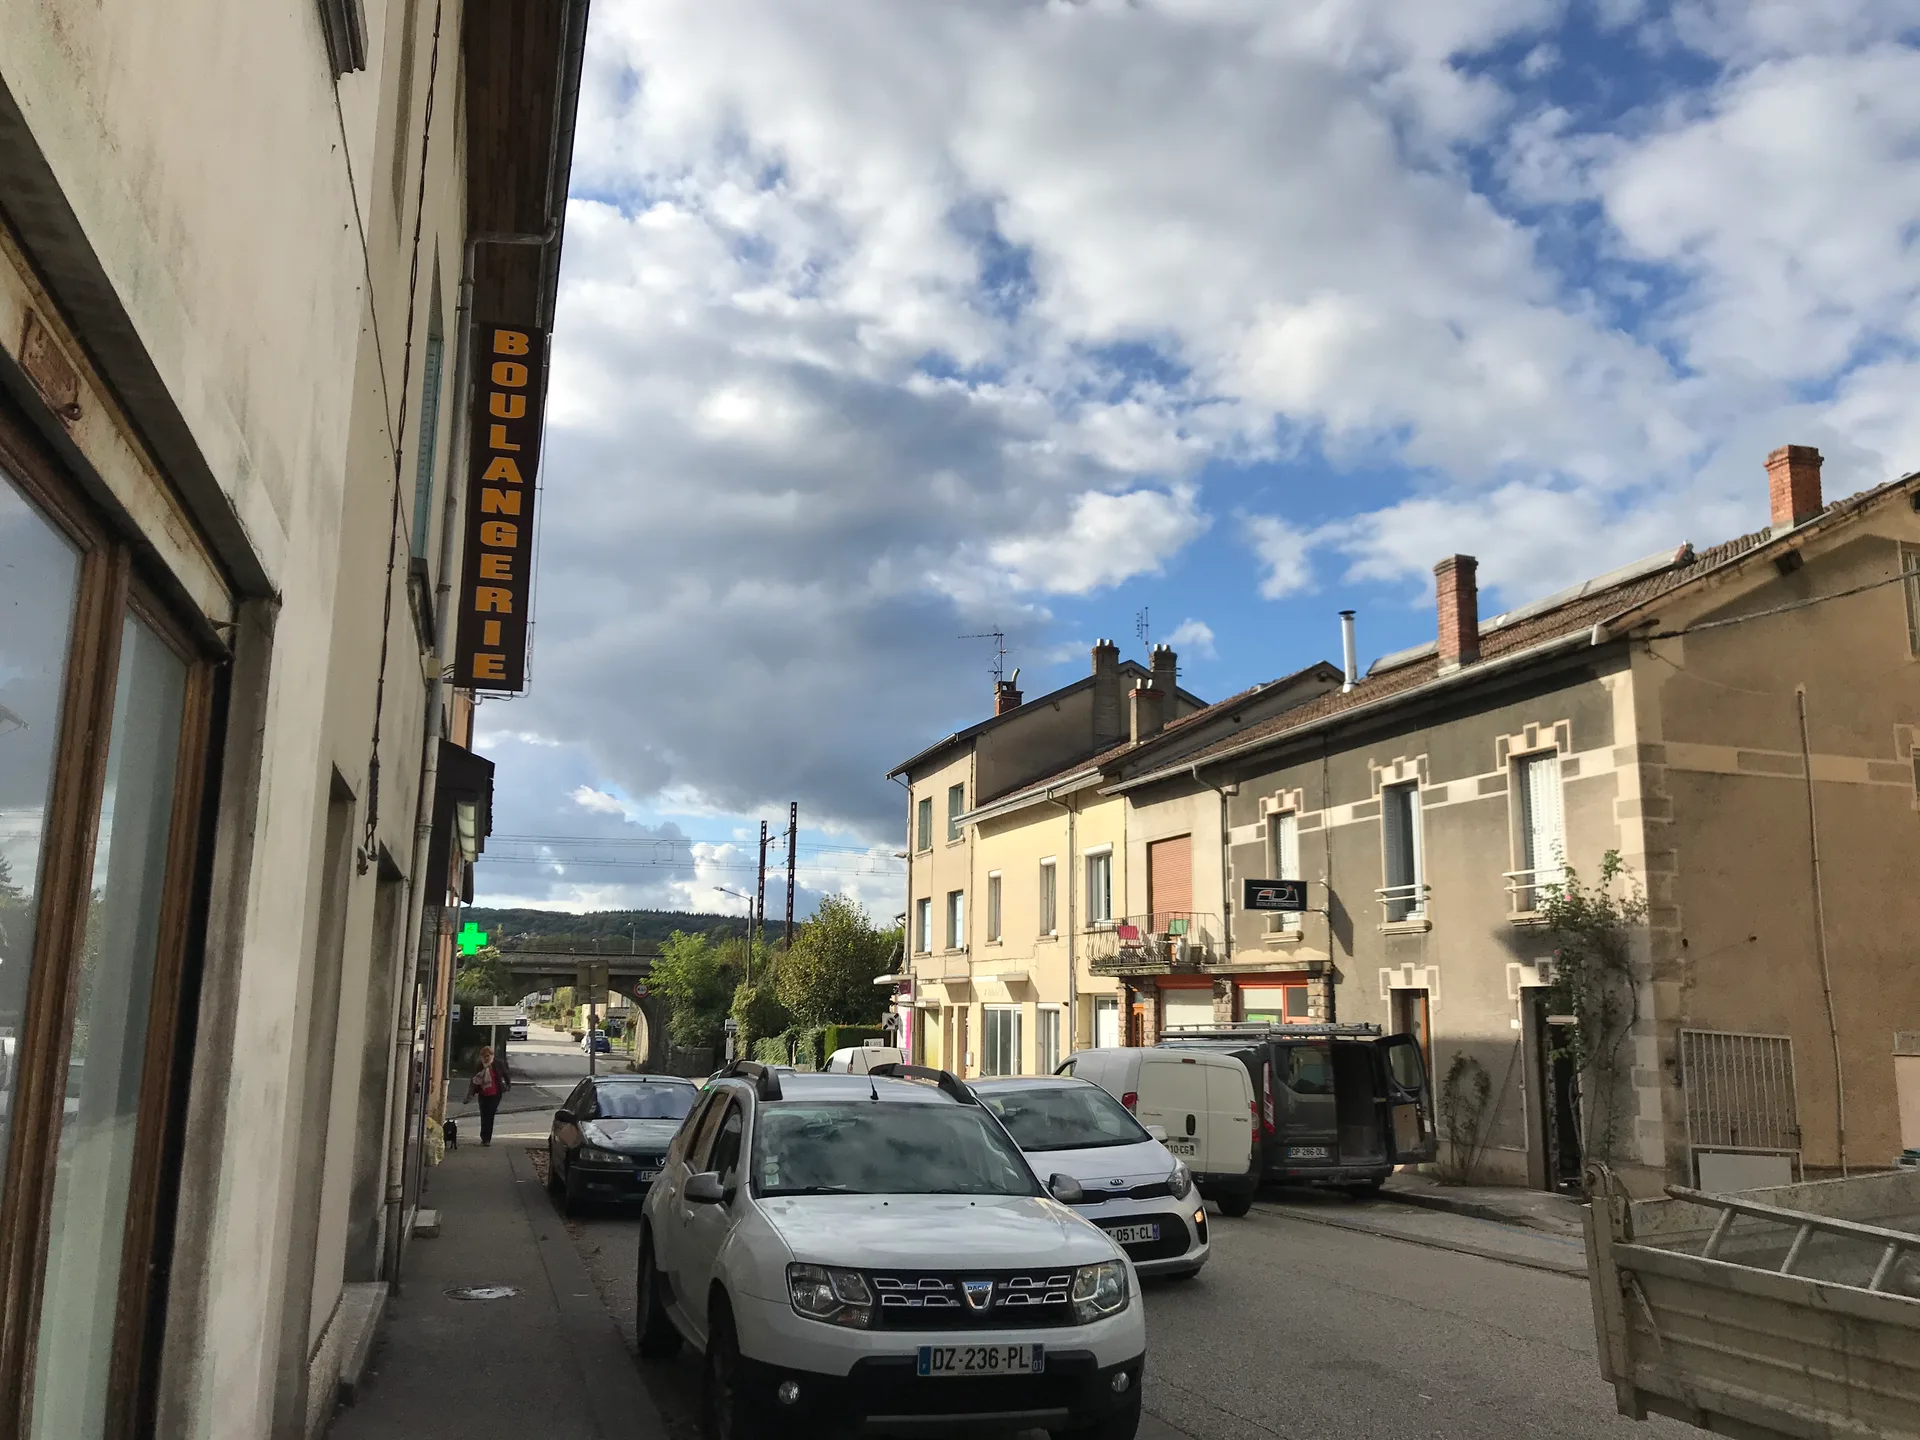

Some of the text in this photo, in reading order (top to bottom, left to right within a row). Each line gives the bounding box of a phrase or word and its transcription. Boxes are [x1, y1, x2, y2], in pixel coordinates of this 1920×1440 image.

[473, 329, 530, 681] BOULANGERIE
[932, 1346, 1029, 1370] DZ-236-PL
[1033, 1359, 1042, 1370] 01
